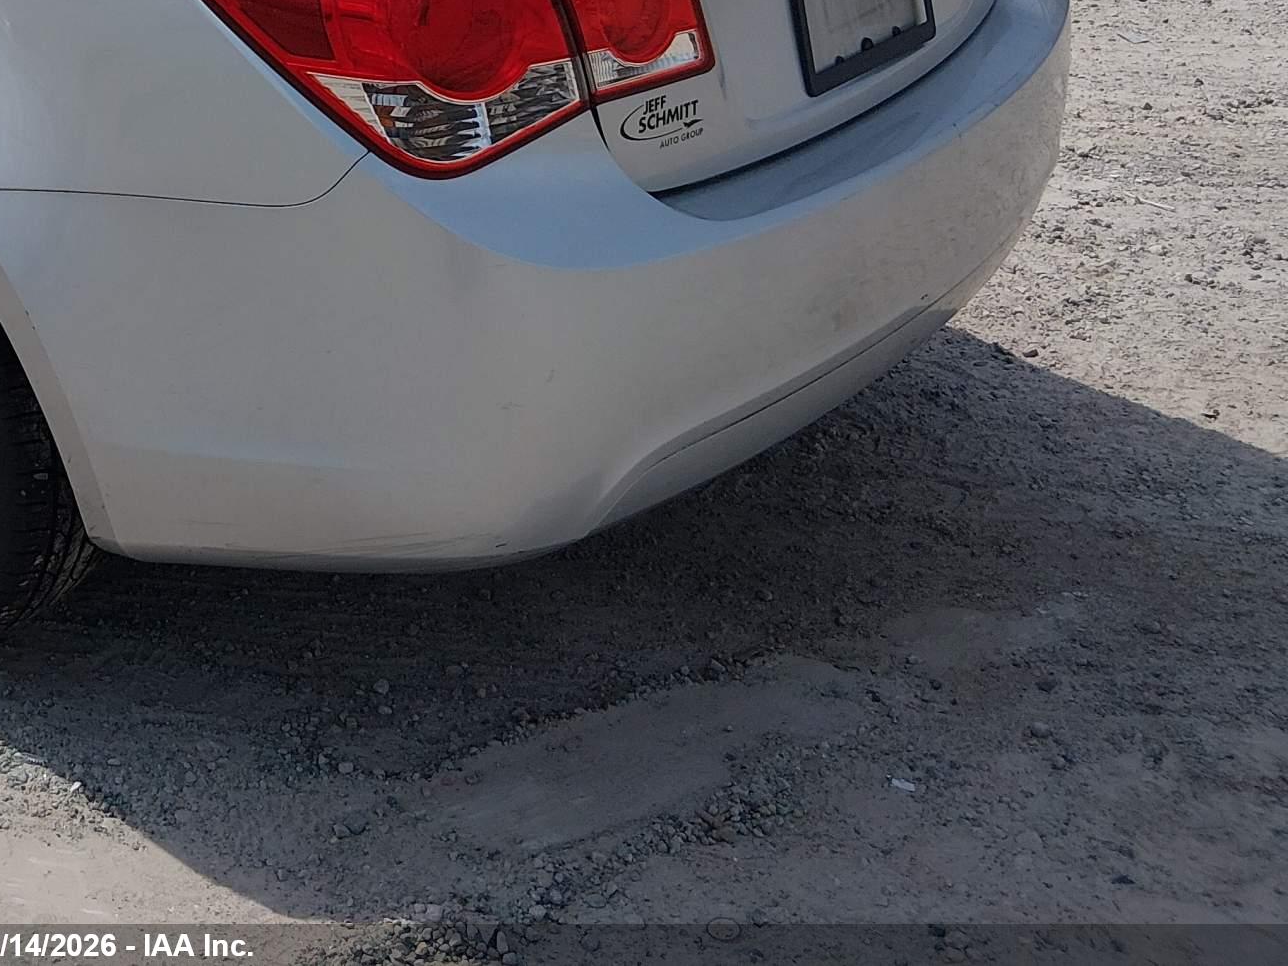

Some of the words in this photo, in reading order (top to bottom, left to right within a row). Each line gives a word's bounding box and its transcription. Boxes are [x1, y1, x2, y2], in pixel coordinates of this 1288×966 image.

[643, 95, 667, 115] JEFF
[638, 100, 699, 134] SCHMITT
[659, 136, 680, 150] AUTO
[681, 127, 704, 142] GROUP
